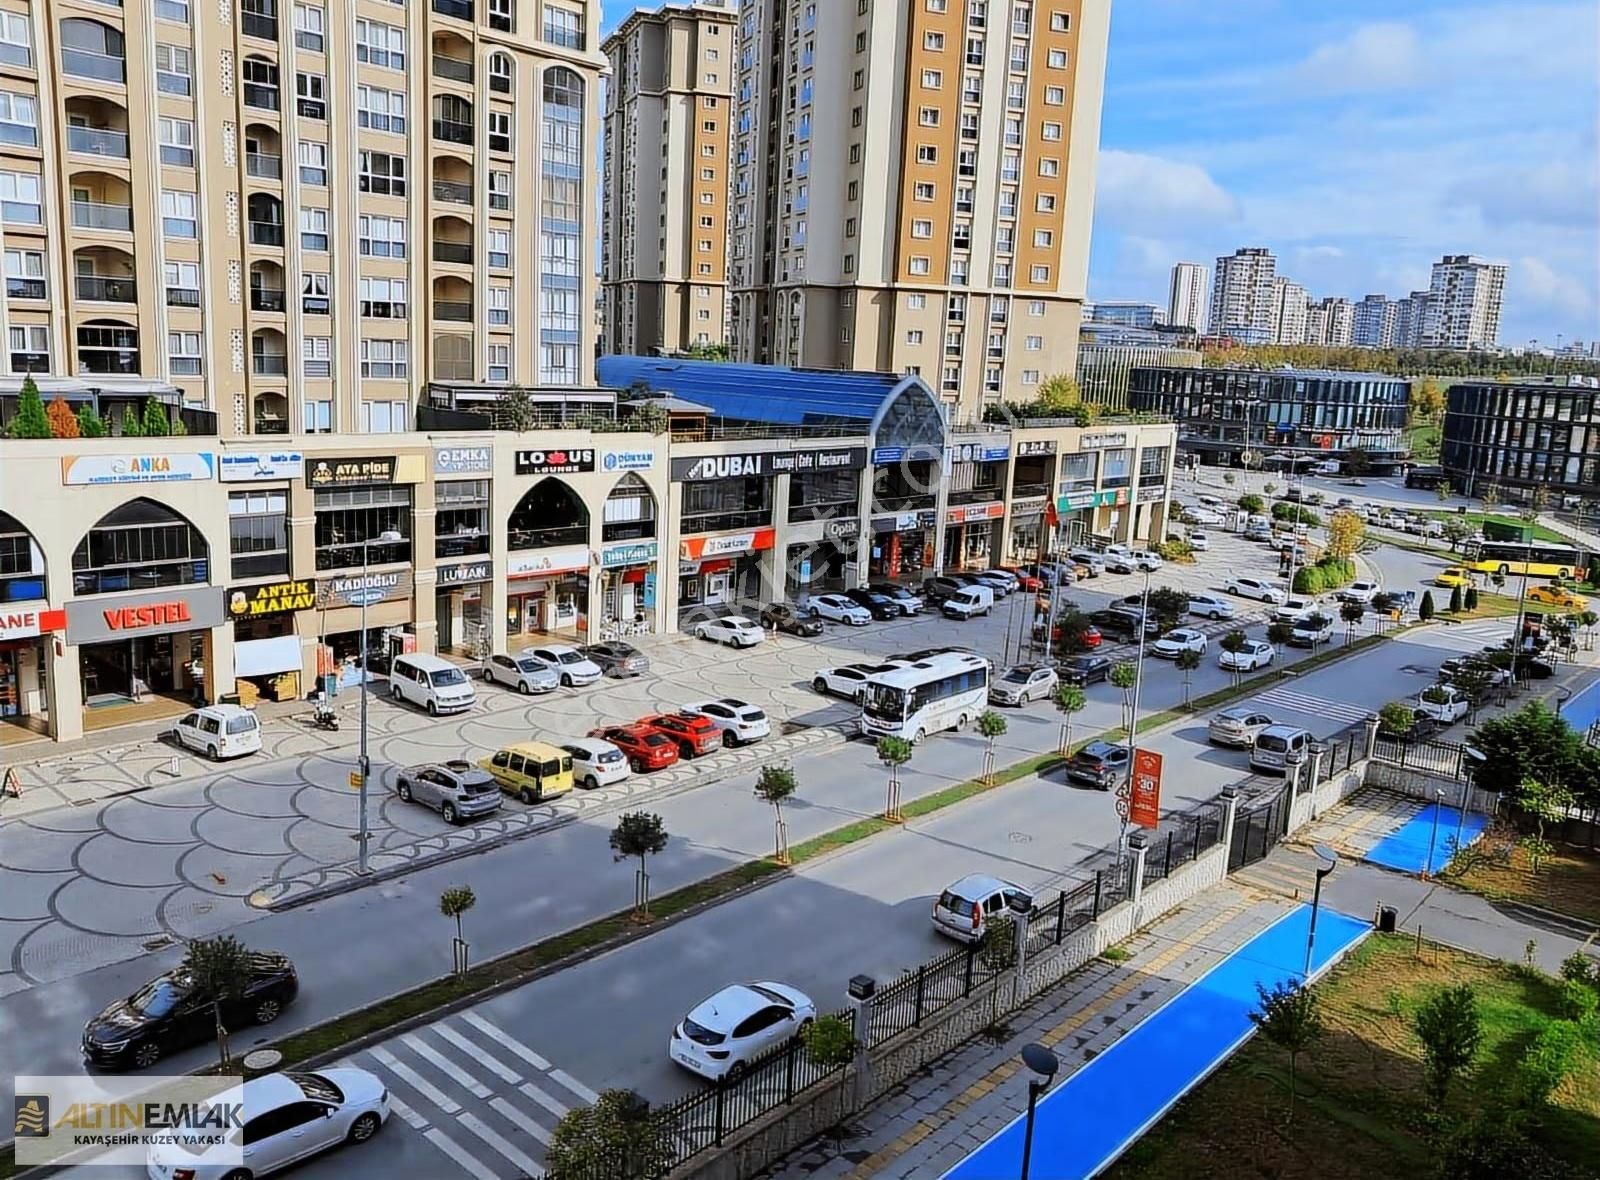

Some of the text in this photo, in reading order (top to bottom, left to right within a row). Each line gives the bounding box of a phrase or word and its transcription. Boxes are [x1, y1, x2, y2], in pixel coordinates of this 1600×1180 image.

[130, 457, 170, 472] ANKA
[336, 461, 390, 475] ATA PİDE
[702, 455, 762, 478] DUBAI
[831, 522, 858, 536] Optik
[256, 582, 310, 599] ANTİK
[250, 594, 315, 615] MANAV
[104, 601, 191, 630] VESTEL
